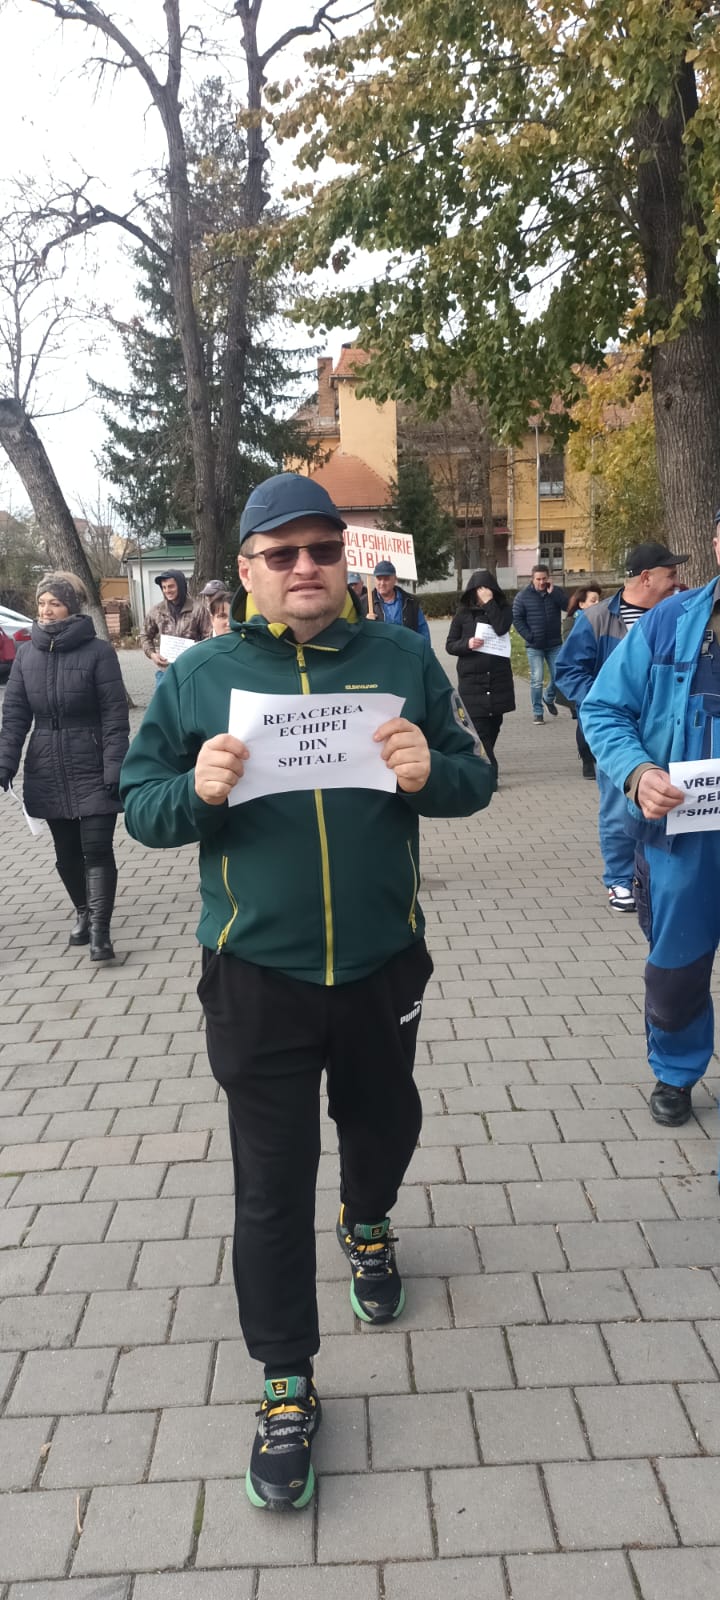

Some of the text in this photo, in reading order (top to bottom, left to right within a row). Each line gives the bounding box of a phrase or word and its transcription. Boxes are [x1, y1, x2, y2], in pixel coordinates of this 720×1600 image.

[263, 704, 364, 726] REFACEREA
[279, 719, 347, 737] ECHIPEI
[299, 738, 328, 751] DIN
[278, 752, 347, 768] SPITALE
[676, 807, 720, 817] PSIHI
